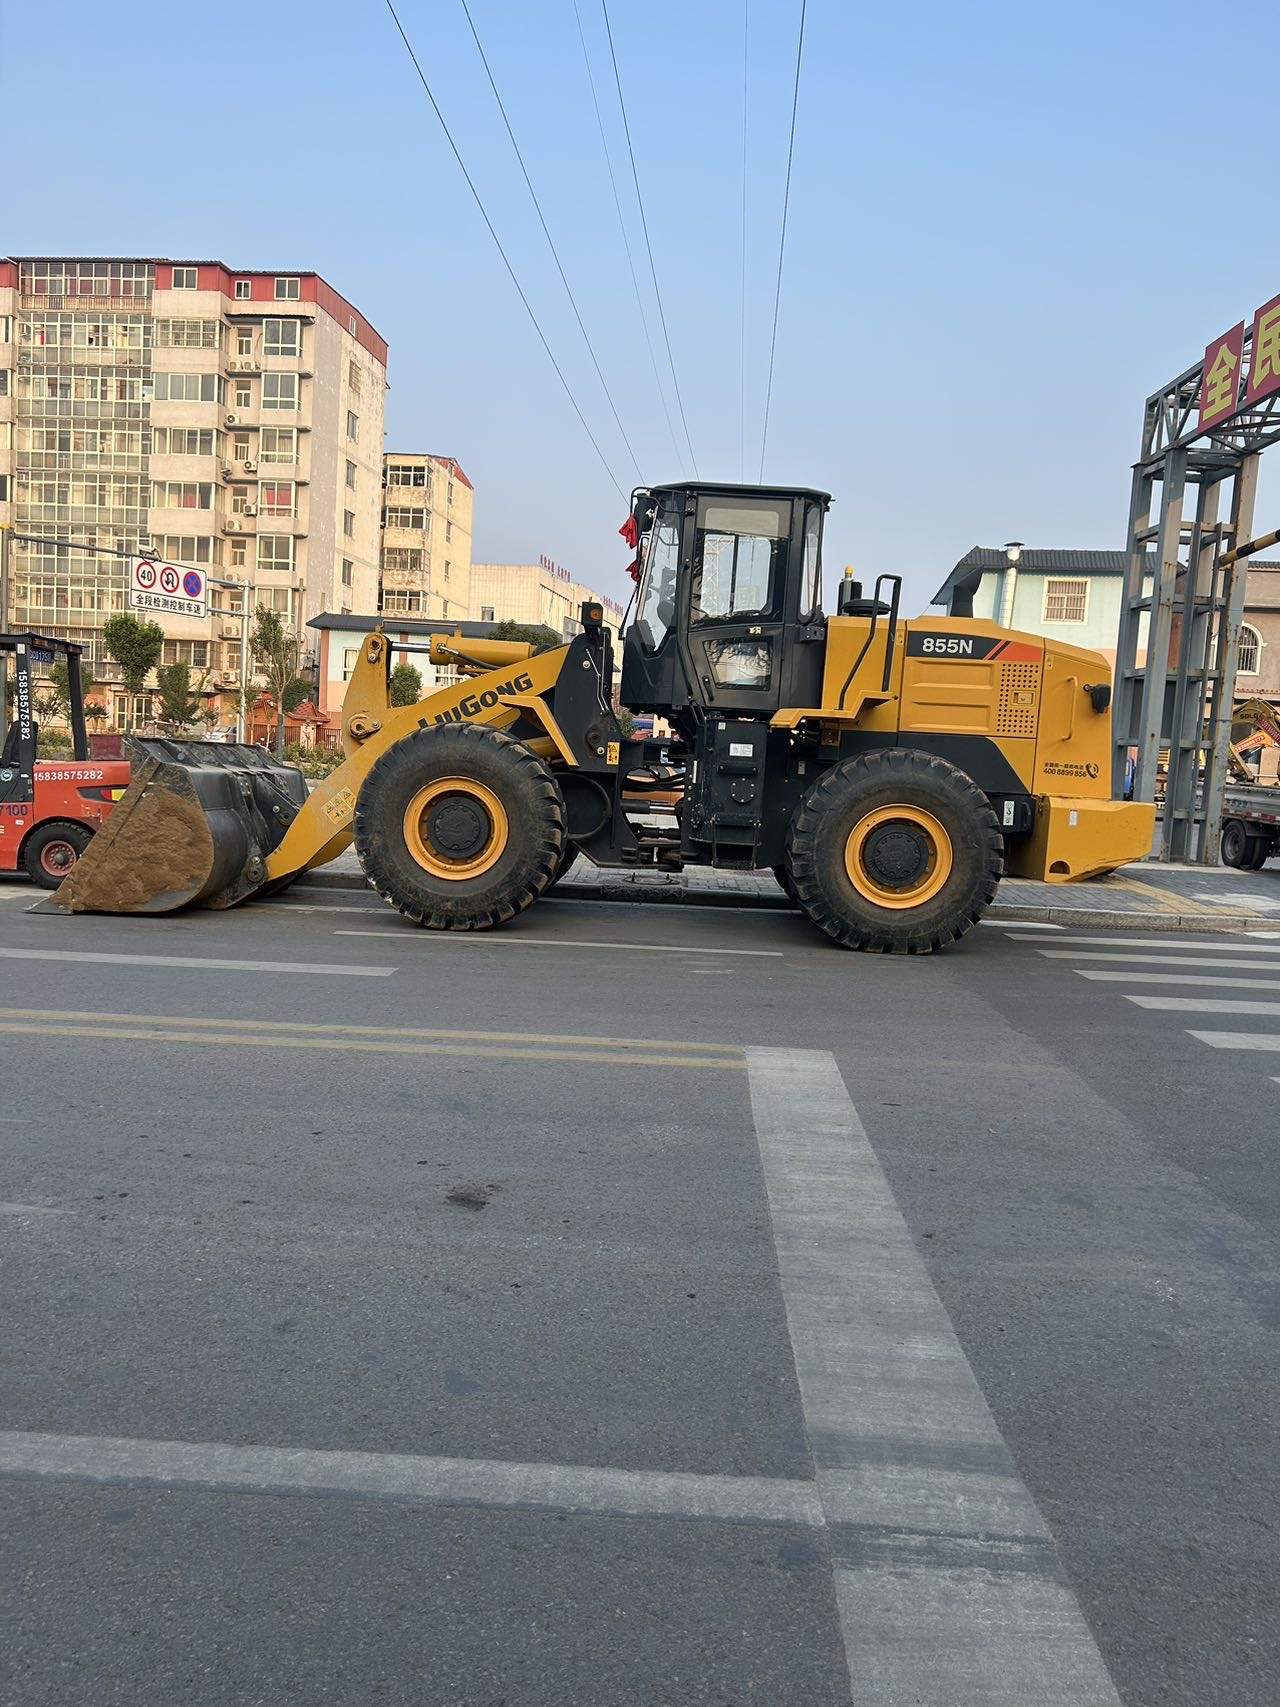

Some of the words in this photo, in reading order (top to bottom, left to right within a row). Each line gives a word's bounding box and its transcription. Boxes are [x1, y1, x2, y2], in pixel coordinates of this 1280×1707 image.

[140, 569, 153, 582] 40
[922, 637, 973, 654] 855N
[18, 670, 31, 740] 15838575282
[33, 770, 104, 781] 15838575282
